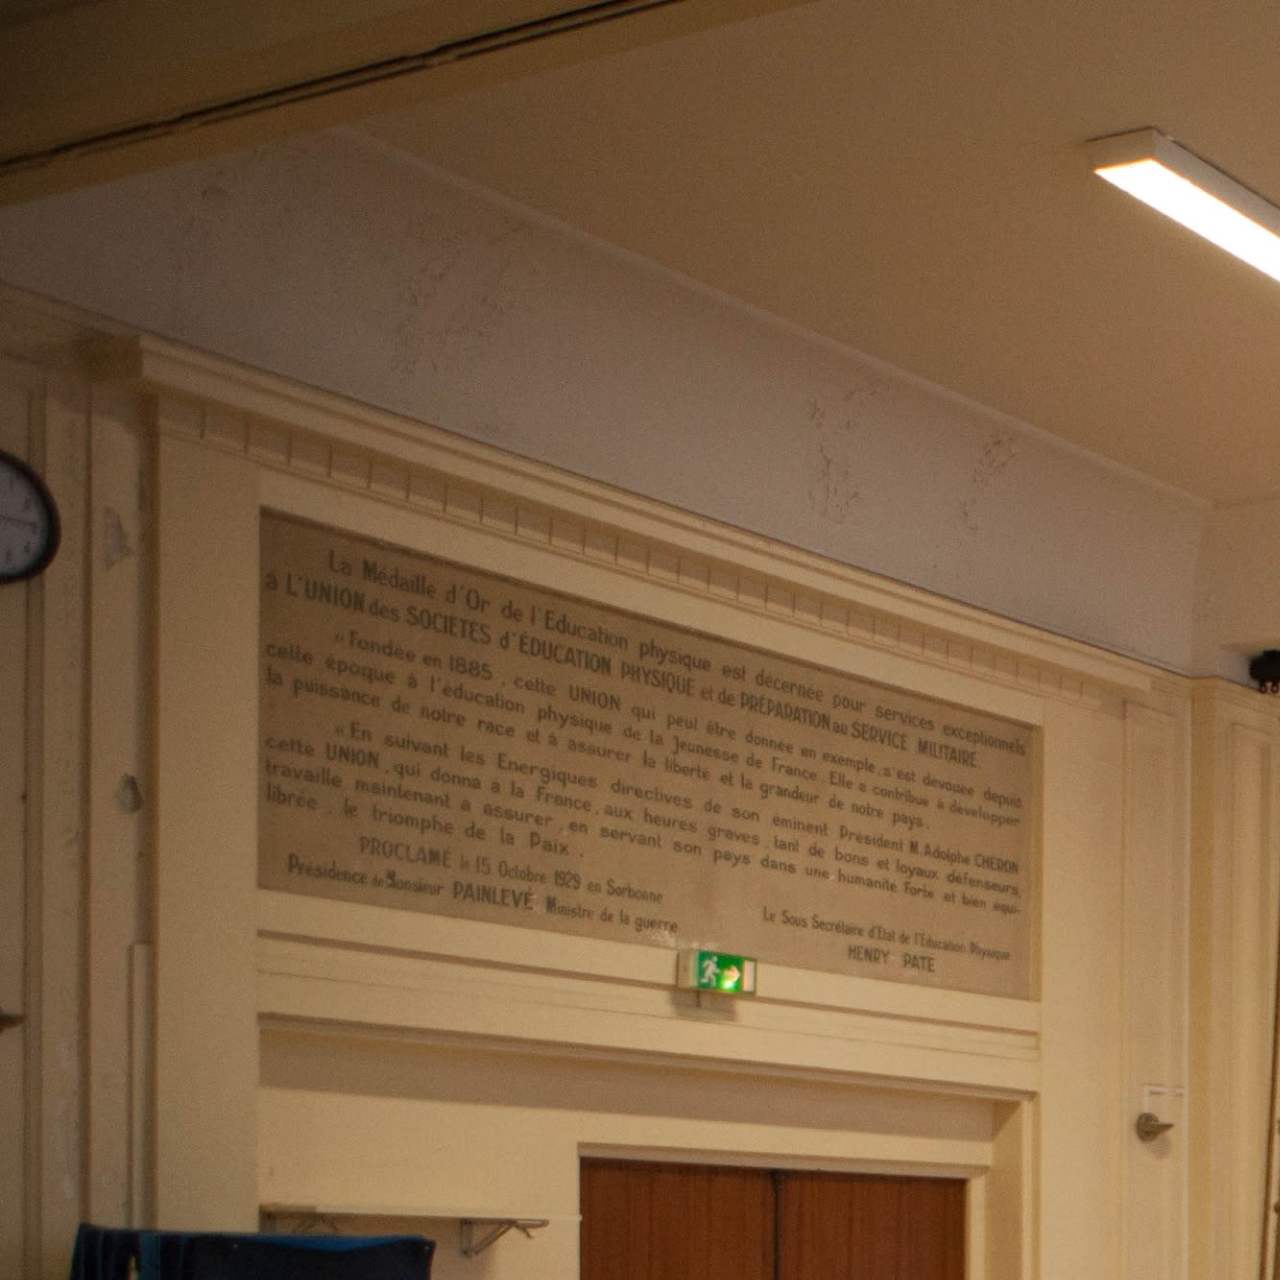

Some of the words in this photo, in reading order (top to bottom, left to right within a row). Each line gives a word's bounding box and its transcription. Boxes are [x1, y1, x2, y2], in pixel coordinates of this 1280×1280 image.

[286, 572, 365, 613] L'UNION
[369, 598, 400, 622] des
[621, 660, 694, 696] PHYSIQUE
[851, 721, 907, 751] SERVICE
[329, 548, 352, 576] La
[445, 583, 491, 612] d'Or
[500, 599, 523, 622] de
[639, 637, 711, 672] physique
[722, 664, 746, 681] est
[832, 693, 866, 712] pour
[875, 705, 934, 730] services
[513, 675, 557, 696] cette
[569, 684, 621, 711] UNION
[631, 705, 656, 722] qui
[666, 713, 698, 730] peut
[265, 643, 313, 665] cette
[537, 703, 612, 735] physique
[830, 770, 854, 789] Elle
[294, 677, 380, 707] puissance
[420, 705, 466, 726] notre
[477, 719, 515, 737] race
[567, 738, 631, 762] assurer
[760, 782, 819, 804] grandeur
[851, 802, 883, 819] notre
[264, 755, 344, 788] travaille
[355, 779, 451, 808] maintenant
[568, 821, 588, 834] en
[599, 826, 662, 848] servant
[673, 841, 702, 856] son
[713, 848, 751, 868] pays
[760, 853, 796, 874] dans
[806, 867, 830, 879] une
[962, 891, 986, 909] bien
[265, 736, 314, 756] cette
[393, 762, 421, 779] qui
[430, 766, 481, 789] donna
[604, 804, 633, 820] aux
[643, 807, 698, 833] heures
[774, 834, 799, 852] tant
[834, 845, 869, 866] bons
[895, 858, 938, 880] loyaux
[371, 802, 454, 837] triomphe
[464, 820, 486, 840] de
[384, 734, 449, 758] suivant
[460, 744, 485, 766] les
[610, 777, 693, 808] directives
[732, 807, 760, 821] son
[923, 842, 970, 865] Adolphe
[498, 859, 546, 884] Octobre
[606, 877, 663, 904] Sorbonne
[545, 895, 591, 918] Ministre
[635, 916, 678, 933] guerre
[782, 909, 807, 928] Sous
[848, 944, 890, 963] HENRY
